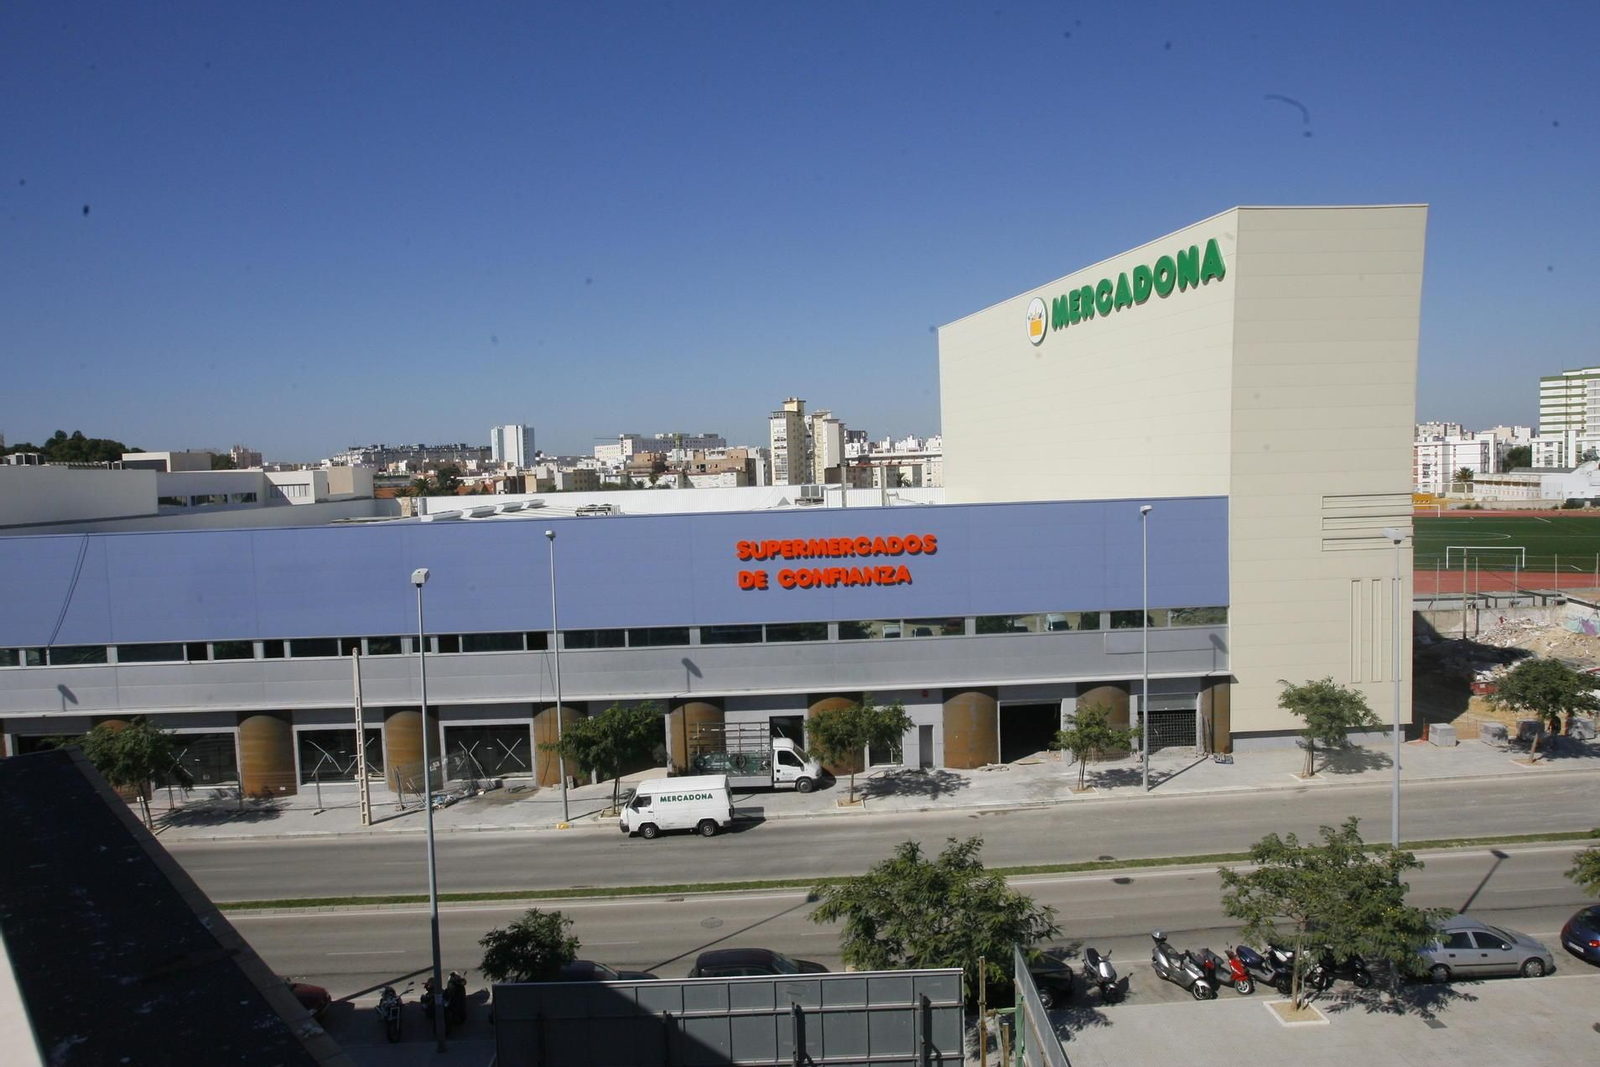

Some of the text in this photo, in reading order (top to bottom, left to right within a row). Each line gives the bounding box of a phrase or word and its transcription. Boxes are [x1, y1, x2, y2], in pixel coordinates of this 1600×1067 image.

[1051, 237, 1226, 332] MERCADONA
[736, 534, 937, 561] SUPERMERCADOS
[738, 565, 912, 590] DE CONFIANZA
[660, 792, 713, 803] MERCADONA
